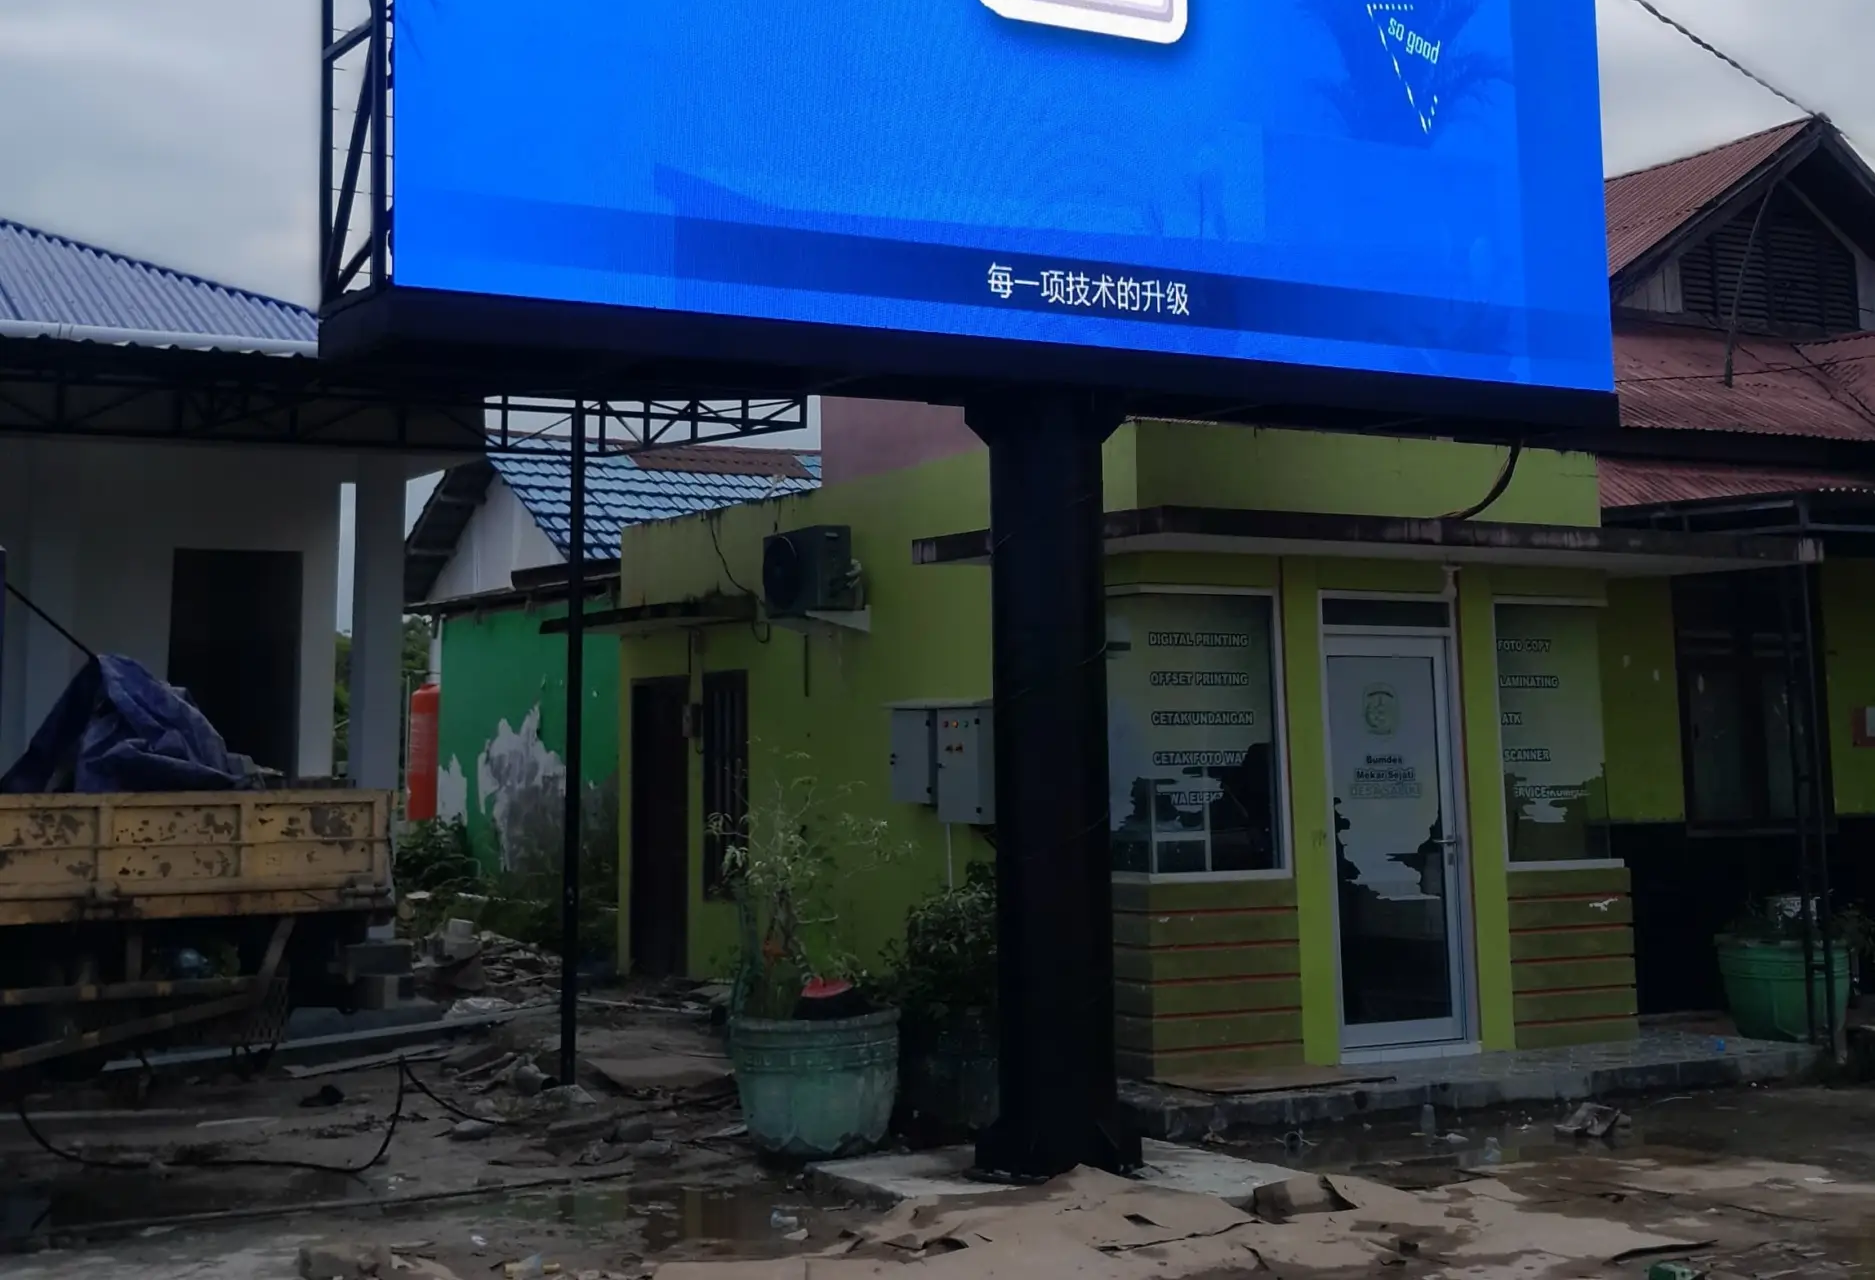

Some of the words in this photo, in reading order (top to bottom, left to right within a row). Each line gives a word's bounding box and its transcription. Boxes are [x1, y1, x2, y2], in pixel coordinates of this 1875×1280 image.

[1388, 17, 1404, 41] so
[1405, 30, 1441, 64] good
[987, 261, 1190, 316] 每一项技术的升级
[1149, 632, 1193, 646] DIGITAL
[1195, 633, 1249, 647] PRINTING
[1497, 639, 1523, 652] FOTO
[1525, 639, 1551, 652] COPY
[1150, 672, 1193, 686] OFFSET
[1195, 672, 1249, 686] PRINTING
[1499, 676, 1559, 688] LAMINATING
[1152, 711, 1190, 725] CETAK
[1190, 711, 1254, 725] UNDANGAN
[1501, 712, 1522, 725] ATK
[1153, 752, 1191, 765] CETAK
[1192, 752, 1223, 765] FOTO
[1503, 749, 1551, 762] SCANNER
